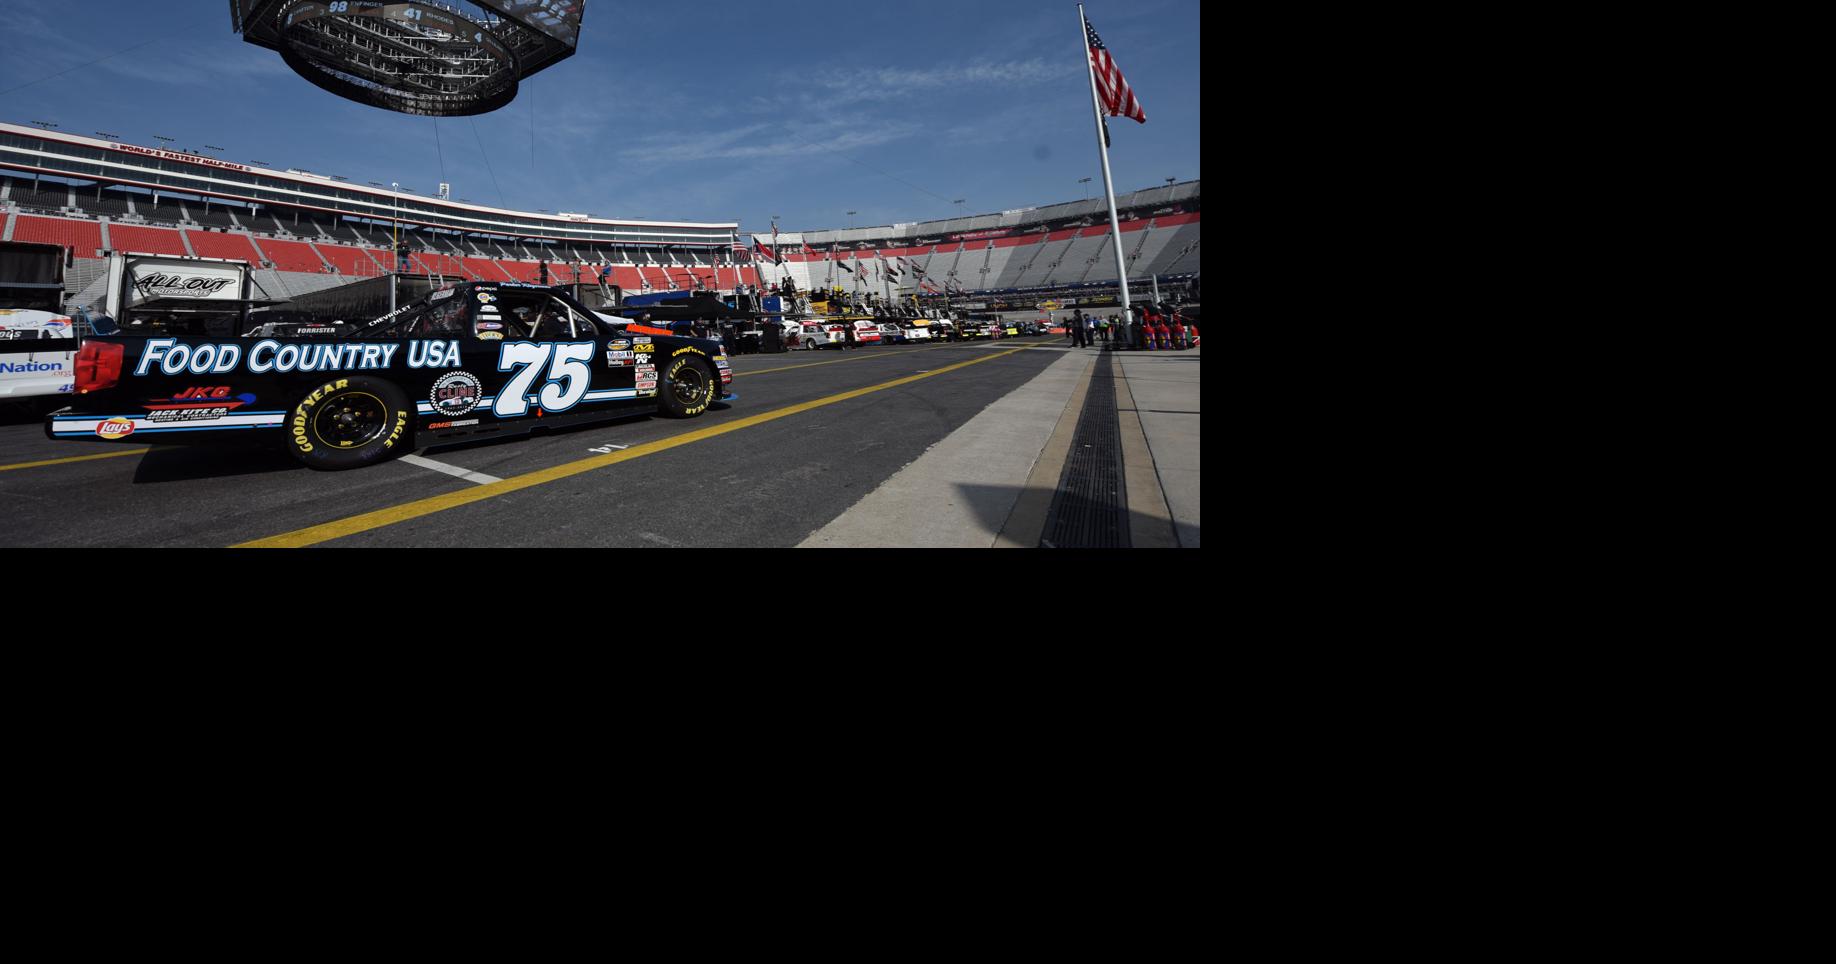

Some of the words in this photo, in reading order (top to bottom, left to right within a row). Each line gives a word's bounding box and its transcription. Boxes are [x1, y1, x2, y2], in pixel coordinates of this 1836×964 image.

[329, 1, 348, 13] 98
[403, 8, 421, 20] 41
[119, 144, 161, 156] WORLD'S
[164, 152, 200, 163] FASTEST
[202, 159, 244, 170] HALF-MILE
[133, 272, 181, 292] ALL
[183, 277, 236, 292] OUT
[368, 304, 411, 327] CHEVROLET
[0, 361, 62, 373] Nation
[248, 339, 399, 375] COUNTRY
[407, 340, 462, 369] USA
[493, 340, 596, 418] 75
[438, 387, 475, 399] CLINE
[293, 379, 349, 453] GOODYEAR
[383, 411, 407, 449] EAGLE
